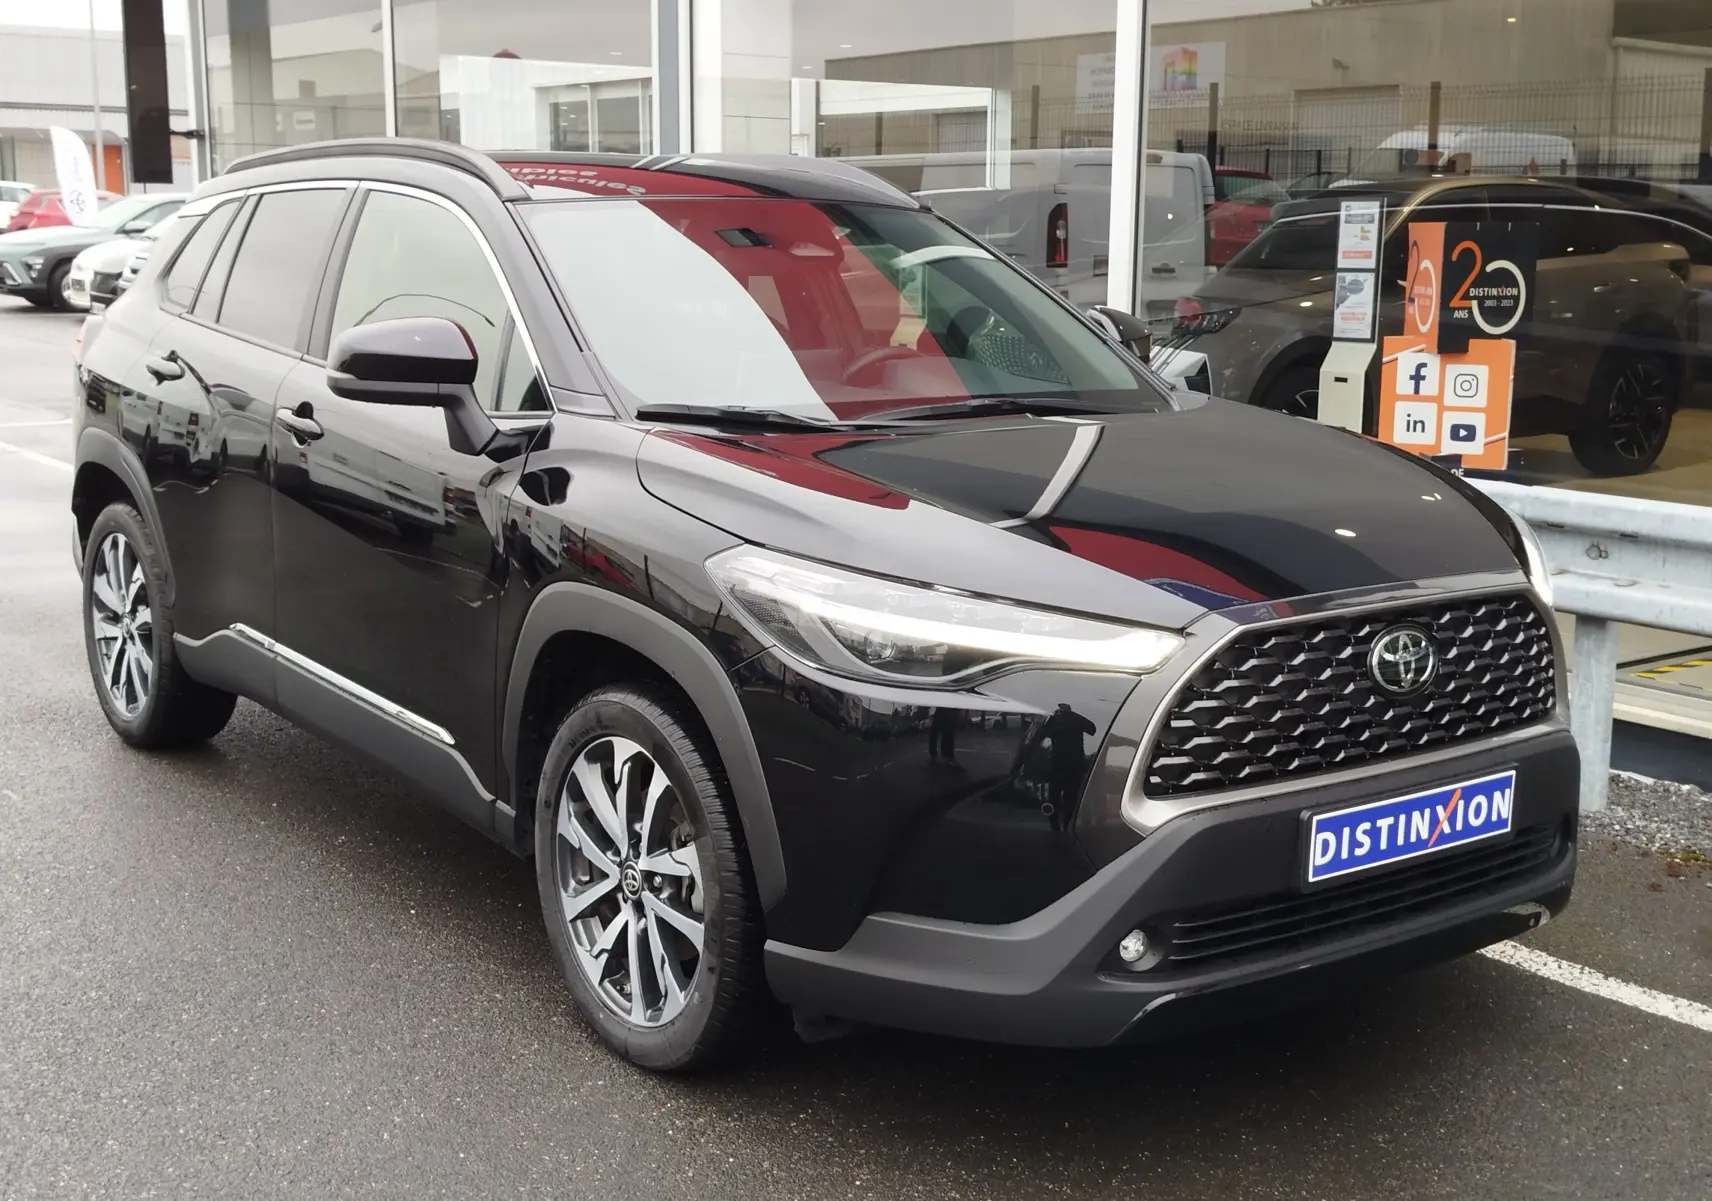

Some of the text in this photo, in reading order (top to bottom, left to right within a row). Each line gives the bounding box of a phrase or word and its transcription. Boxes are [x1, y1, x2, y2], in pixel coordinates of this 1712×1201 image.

[1469, 285, 1519, 297] DISTINXION
[1453, 310, 1469, 319] ANS
[1405, 413, 1426, 433] in
[1314, 788, 1512, 866] DISTINXION
